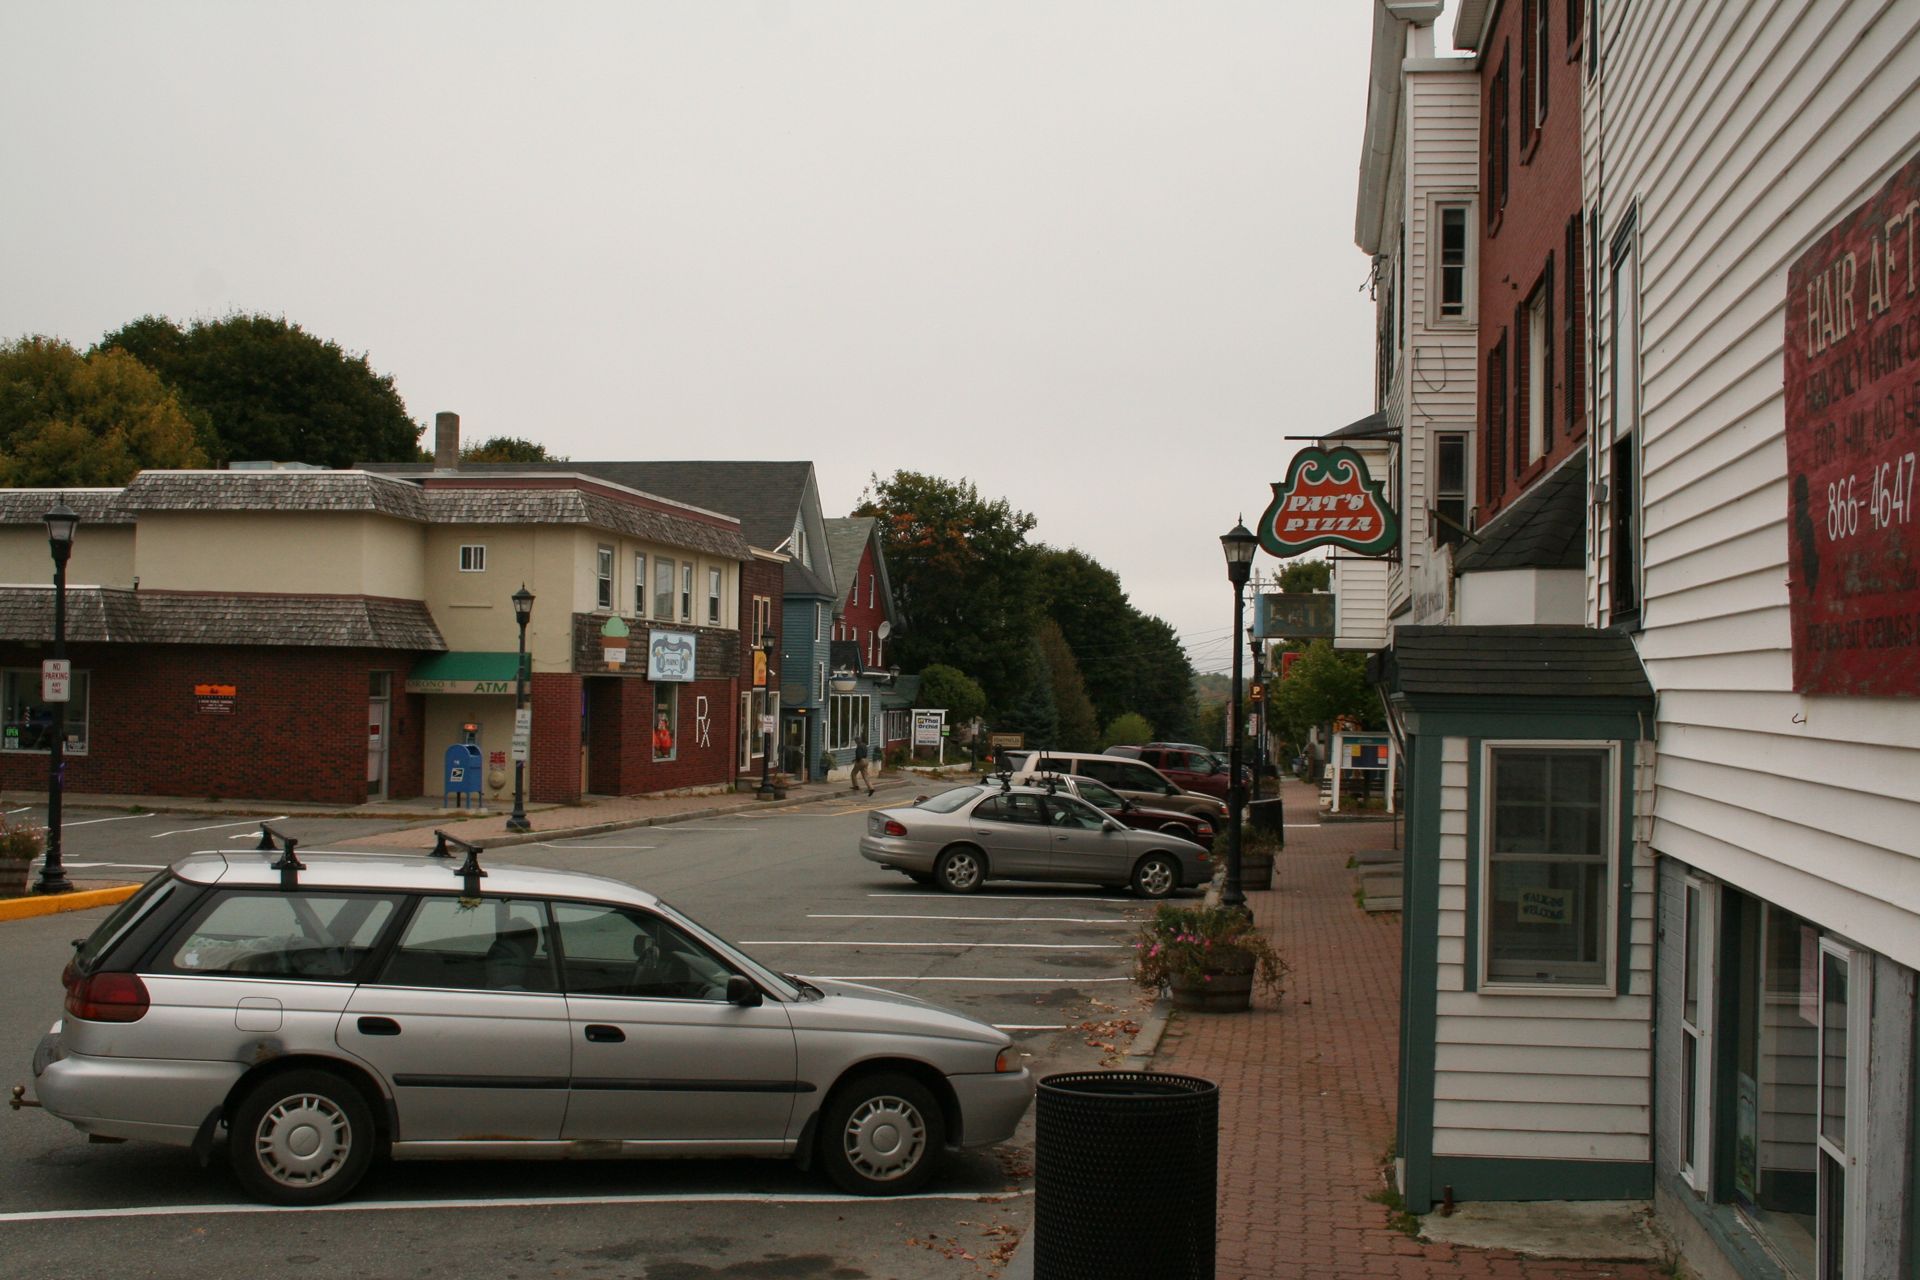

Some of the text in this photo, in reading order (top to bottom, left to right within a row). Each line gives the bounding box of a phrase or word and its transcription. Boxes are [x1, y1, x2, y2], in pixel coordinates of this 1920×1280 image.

[1807, 251, 1858, 359] HAIR
[1286, 493, 1366, 512] PAT'S
[1828, 452, 1915, 541] 866-4647
[1283, 516, 1373, 532] PIZZA
[52, 663, 61, 671] NO
[45, 672, 69, 680] PARKING
[473, 682, 508, 693] ATM
[6, 728, 19, 737] OPEN
